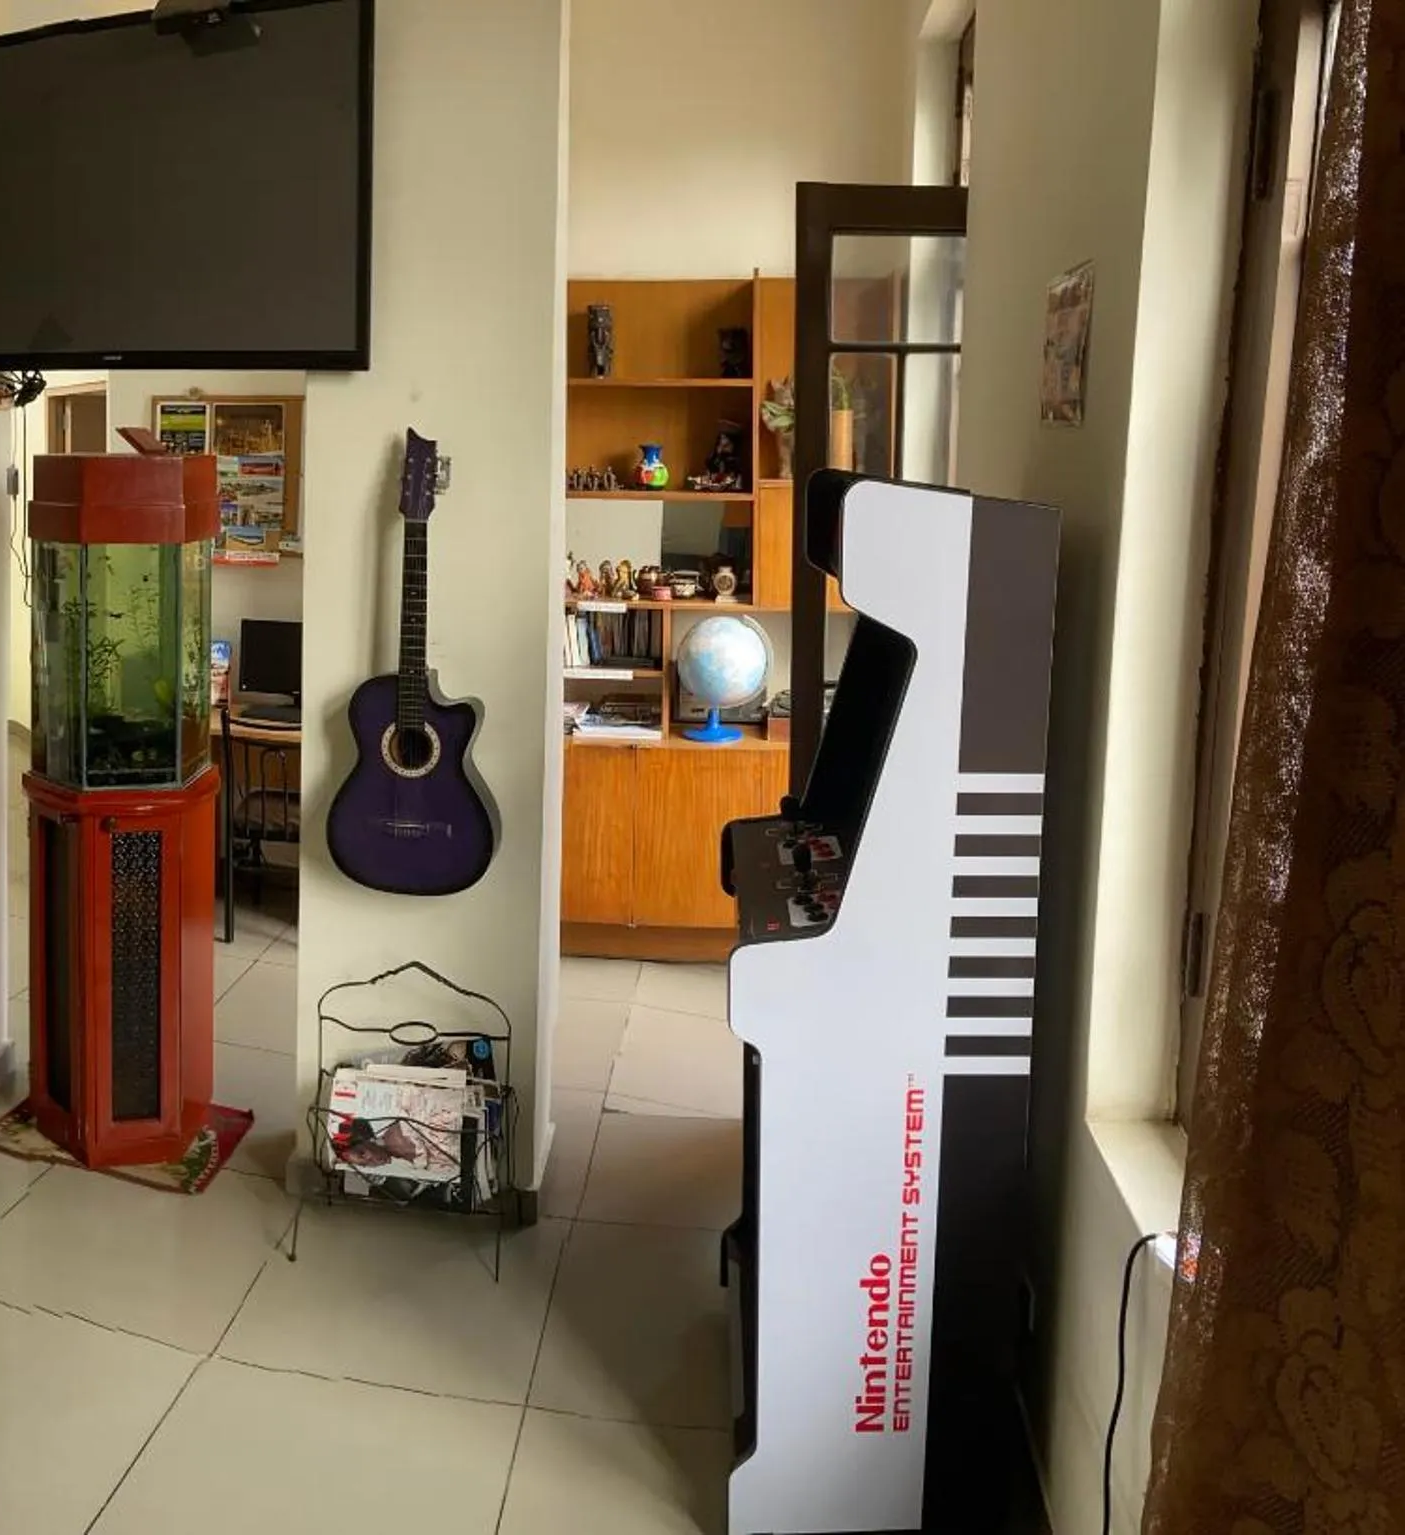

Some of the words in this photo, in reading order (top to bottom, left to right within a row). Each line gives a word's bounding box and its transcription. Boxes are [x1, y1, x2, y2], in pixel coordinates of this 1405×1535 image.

[901, 1089, 925, 1205] SYSTEM
[853, 1253, 891, 1433] Nintendo
[893, 1214, 918, 1431] ENTERTAINMENT
